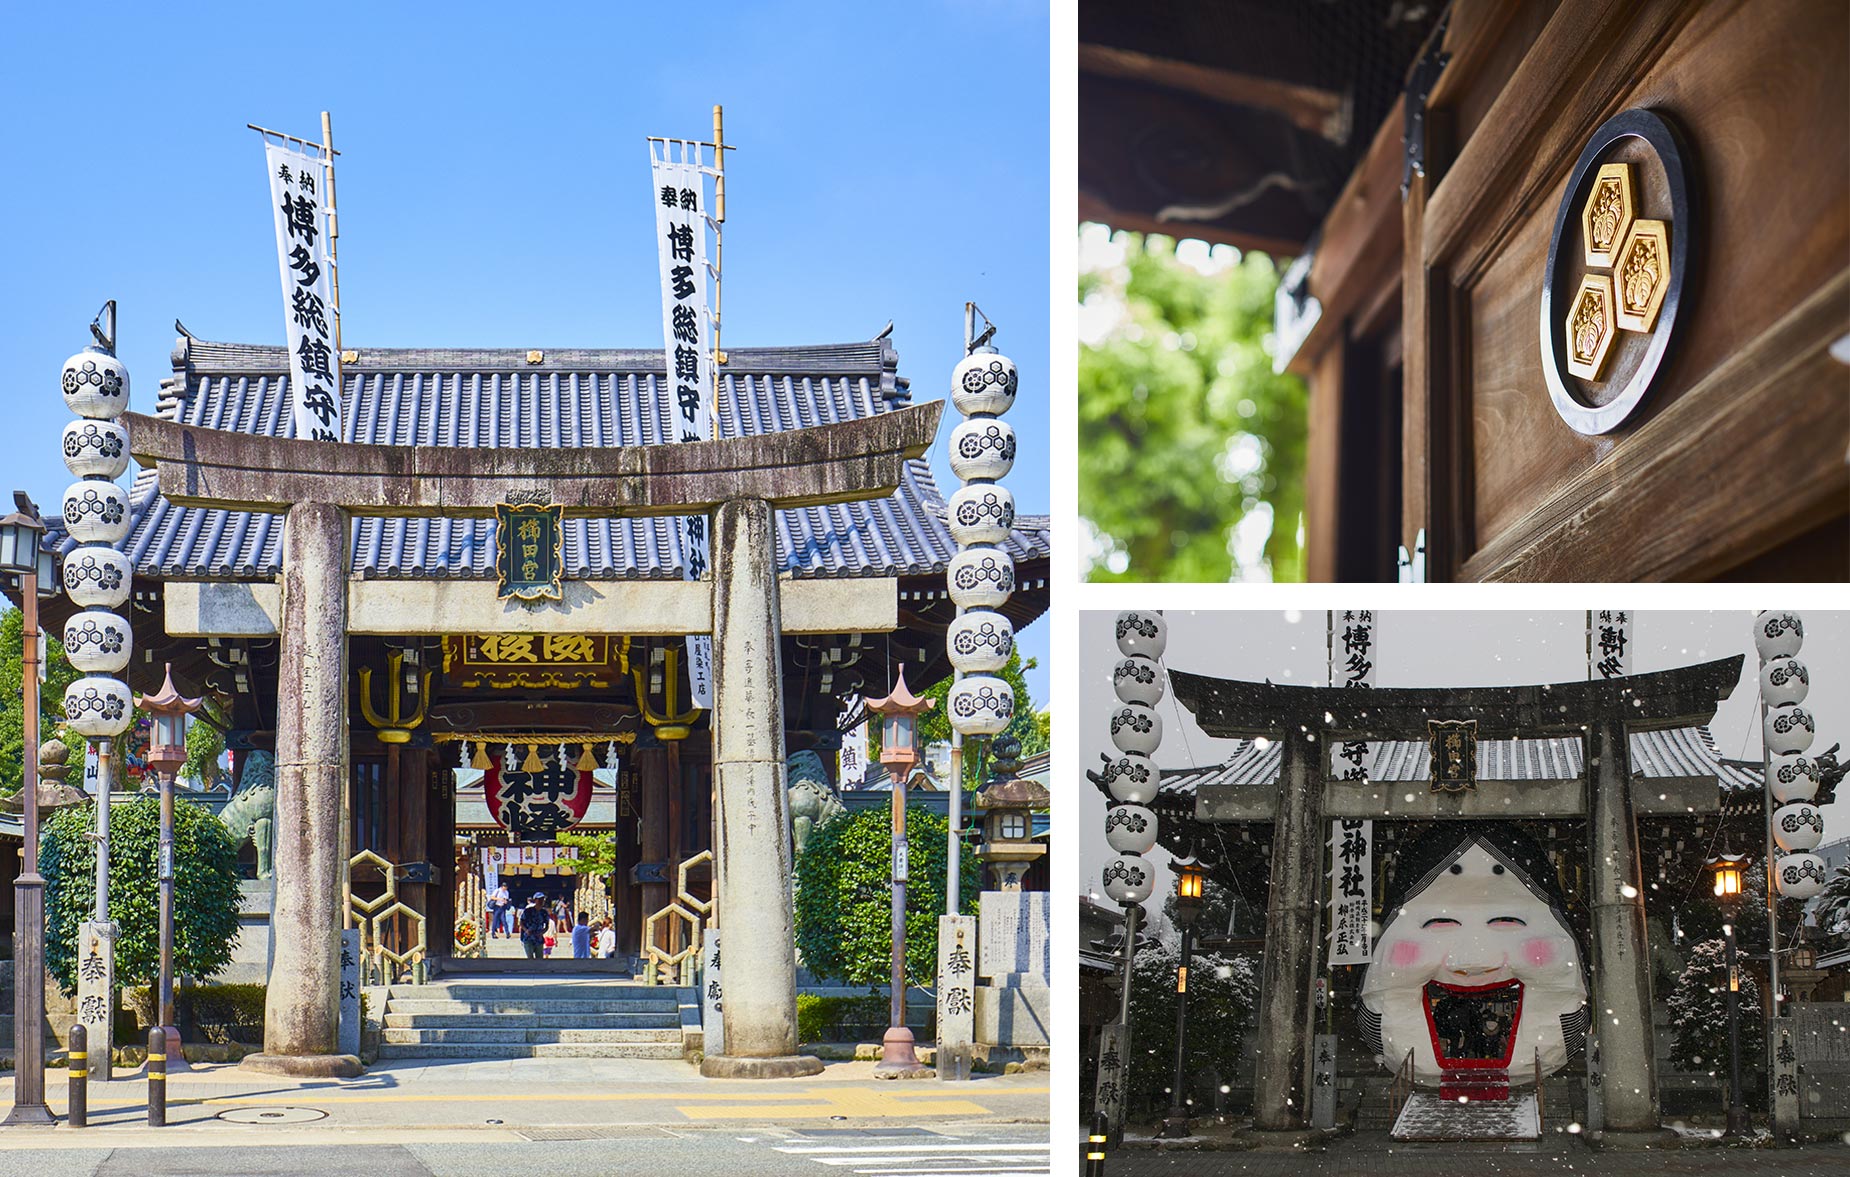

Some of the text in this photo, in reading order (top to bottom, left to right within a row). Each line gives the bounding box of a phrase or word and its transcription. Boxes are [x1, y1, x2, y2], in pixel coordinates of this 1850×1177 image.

[278, 163, 316, 195] 奉納
[661, 185, 698, 213] 奉納
[517, 518, 541, 581] 櫛田宮
[1341, 624, 1373, 688] 博多
